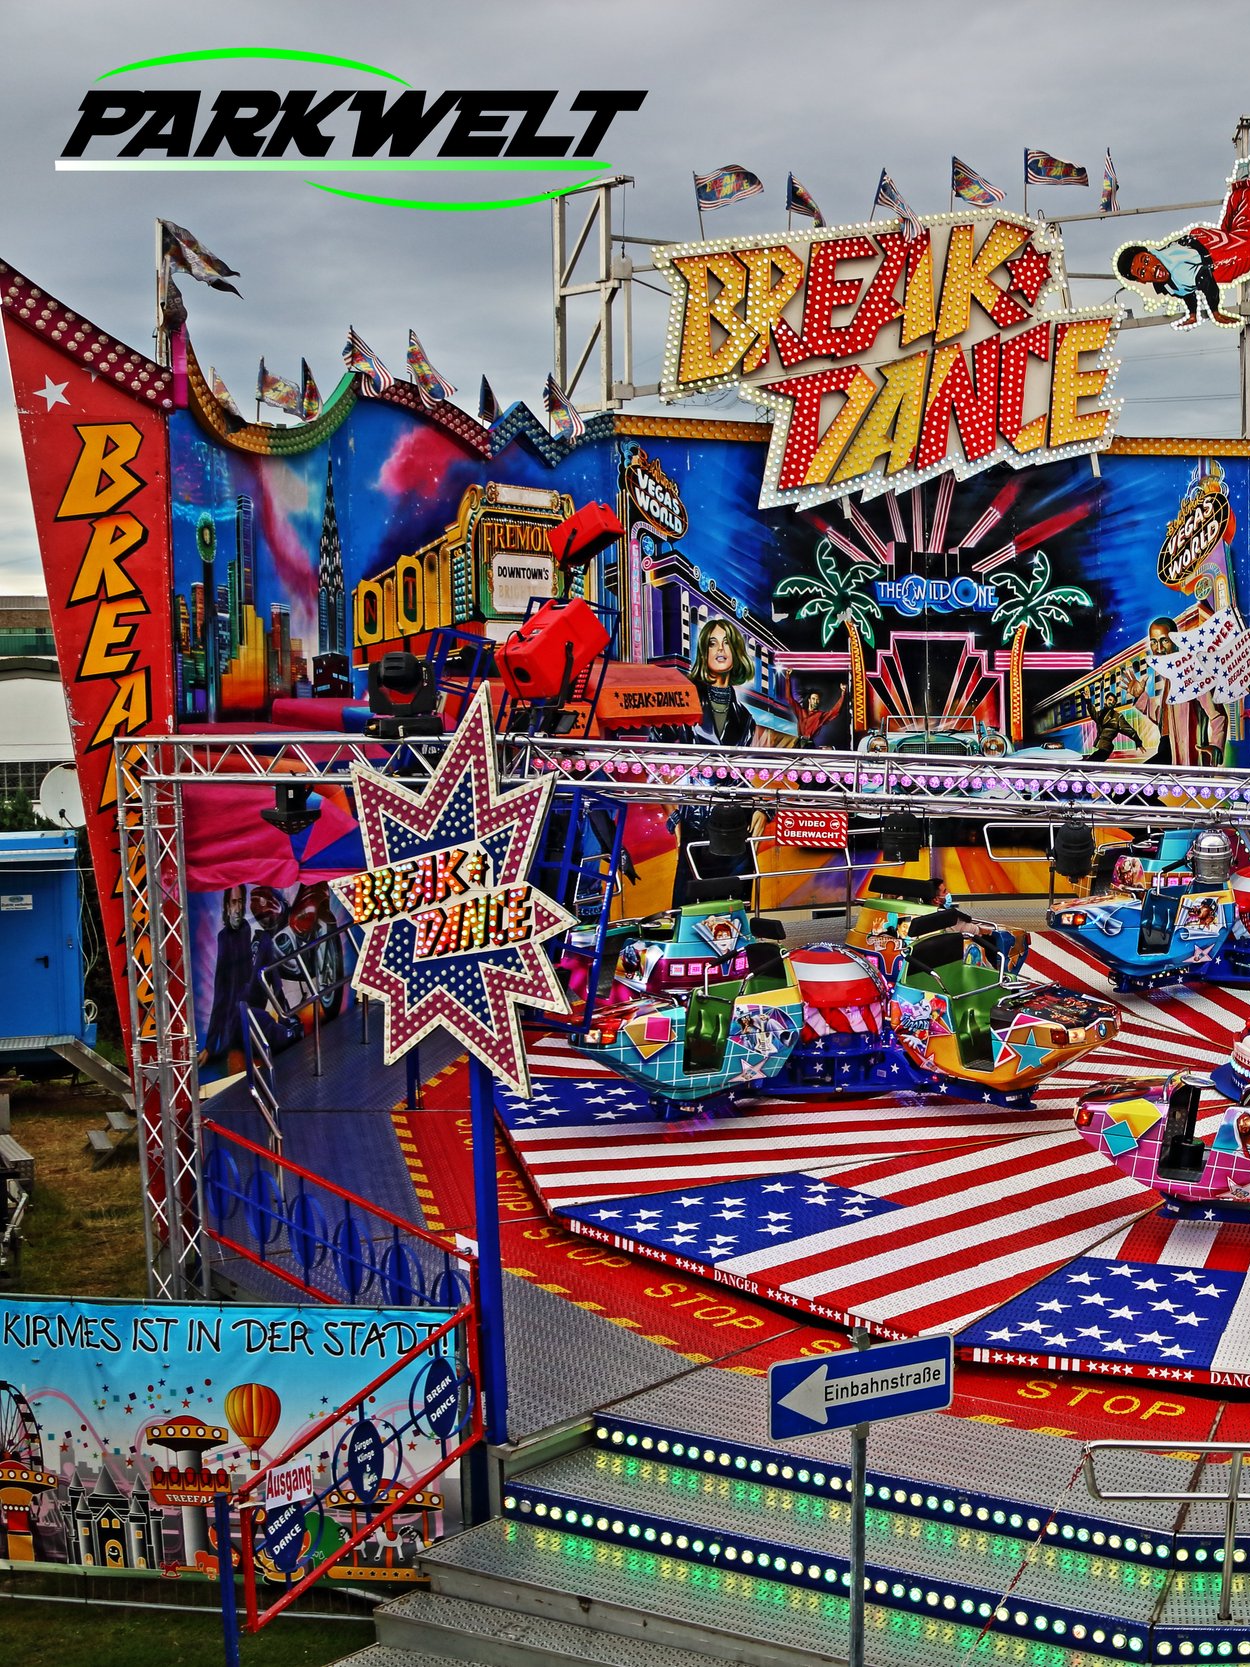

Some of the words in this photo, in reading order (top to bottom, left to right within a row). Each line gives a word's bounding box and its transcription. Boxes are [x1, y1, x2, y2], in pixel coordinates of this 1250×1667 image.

[671, 218, 1037, 384] BREAK
[758, 315, 1115, 489] DANCE
[637, 468, 680, 515] VEGAS
[634, 487, 683, 533] WORLD
[1168, 498, 1215, 555] VEGAS
[1168, 520, 1219, 580] WORLD
[497, 565, 549, 580] DOWNTOWN'S
[878, 582, 902, 599] THE
[908, 578, 951, 605] WILD
[952, 577, 999, 606] ONE
[1207, 620, 1235, 653] OWER
[1220, 651, 1235, 666] DAS
[623, 692, 652, 709] BREAK
[655, 691, 685, 707] DANCE
[784, 829, 840, 839] ÜBERWACHT
[353, 849, 468, 924] BREAK
[411, 886, 532, 958] DANCE
[523, 1226, 632, 1268] STOP
[713, 1268, 760, 1295] DANGER
[643, 1283, 764, 1332] STOP
[4, 1312, 122, 1352] KIRMES
[132, 1317, 178, 1352] IST
[188, 1318, 222, 1352] IN
[231, 1319, 314, 1356] DER
[323, 1321, 449, 1358] STADT!
[426, 1375, 452, 1403] BREAK
[824, 1367, 941, 1402] Einbahnstraße
[1016, 1379, 1187, 1421] STOP
[430, 1394, 456, 1422] DANCE
[354, 1437, 373, 1452] Jürgen
[356, 1449, 375, 1464] Klinge
[266, 1464, 313, 1501] Ausgang
[267, 1505, 296, 1535] BREAK
[273, 1523, 302, 1556] DANCE
